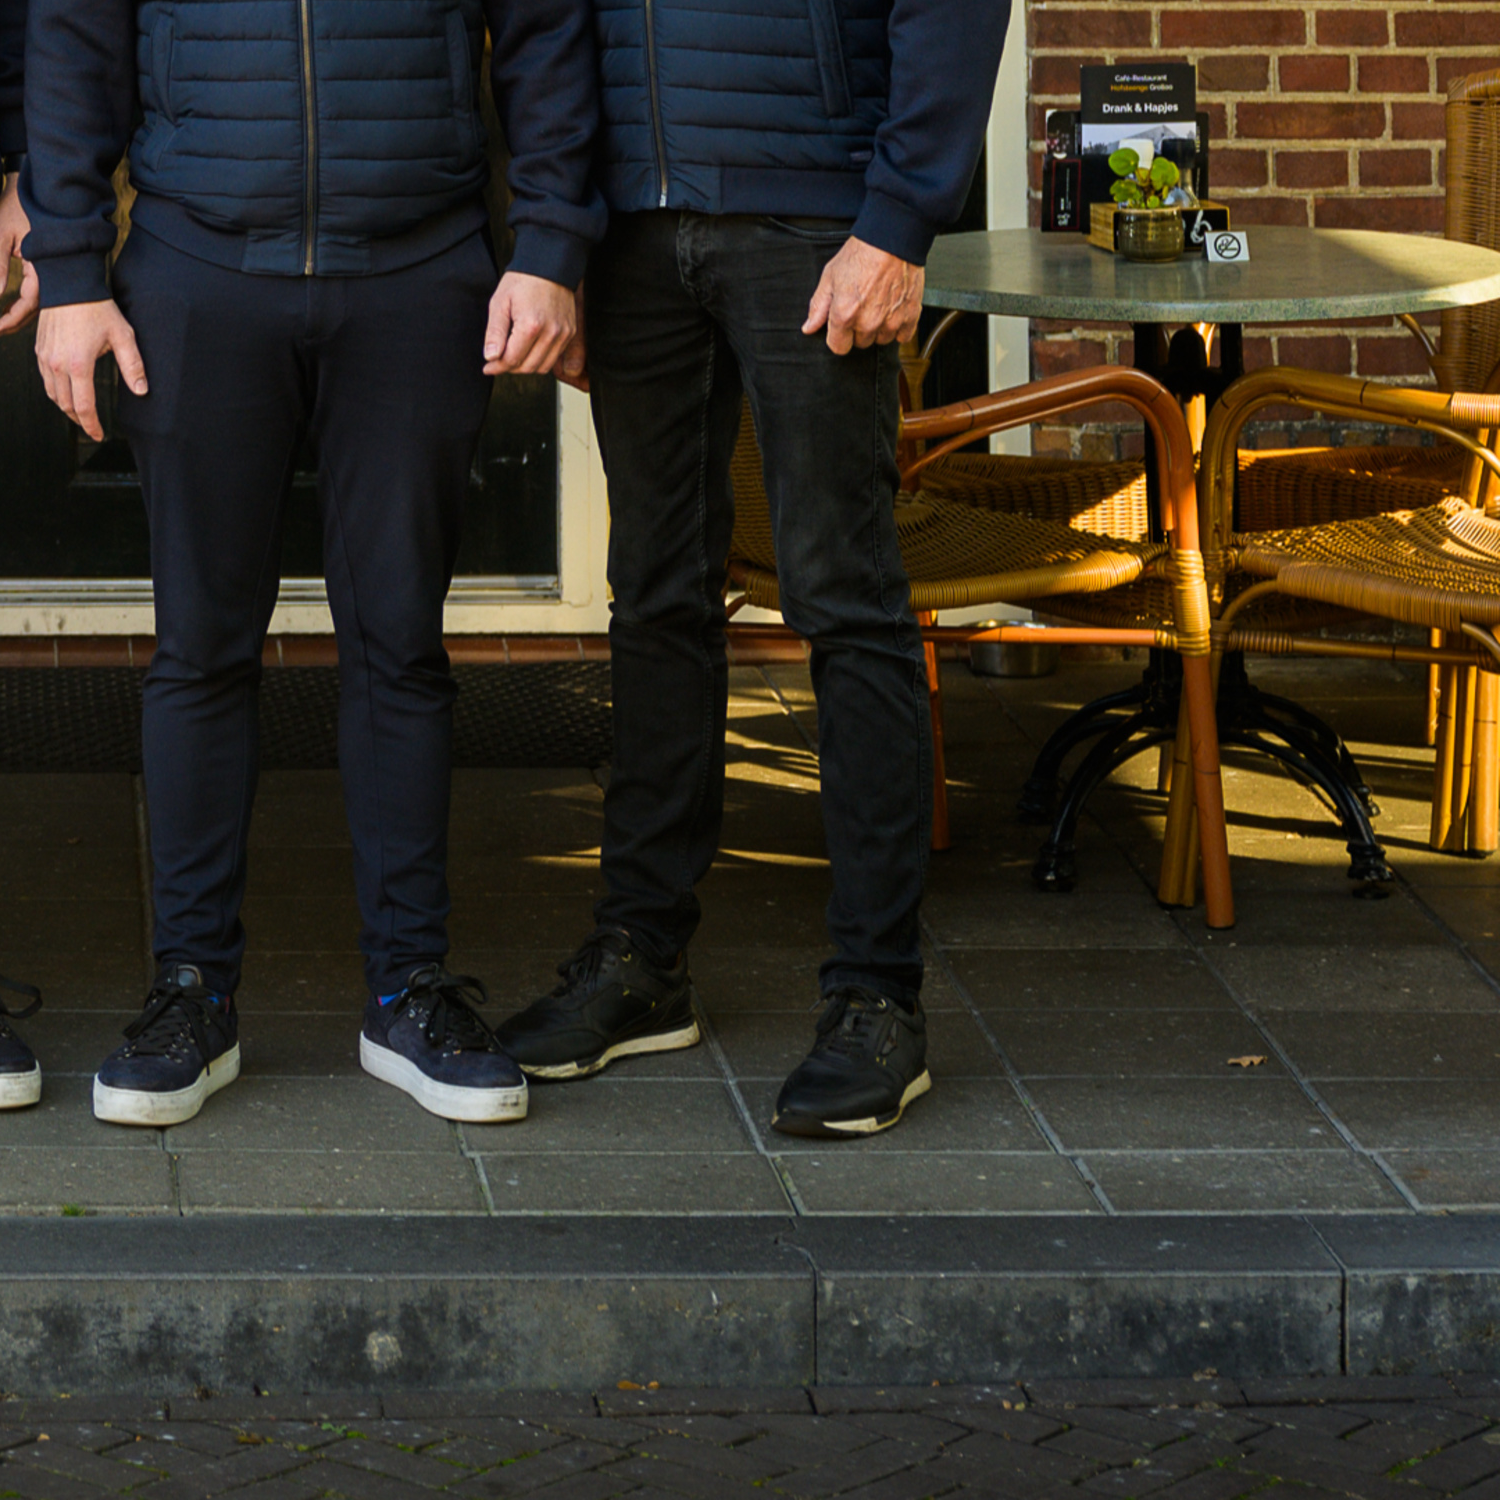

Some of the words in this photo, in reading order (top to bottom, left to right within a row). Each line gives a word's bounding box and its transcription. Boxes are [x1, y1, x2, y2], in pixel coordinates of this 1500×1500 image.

[1102, 102, 1133, 113] Drank
[1134, 102, 1142, 113] &
[1144, 102, 1178, 114] Hapjes
